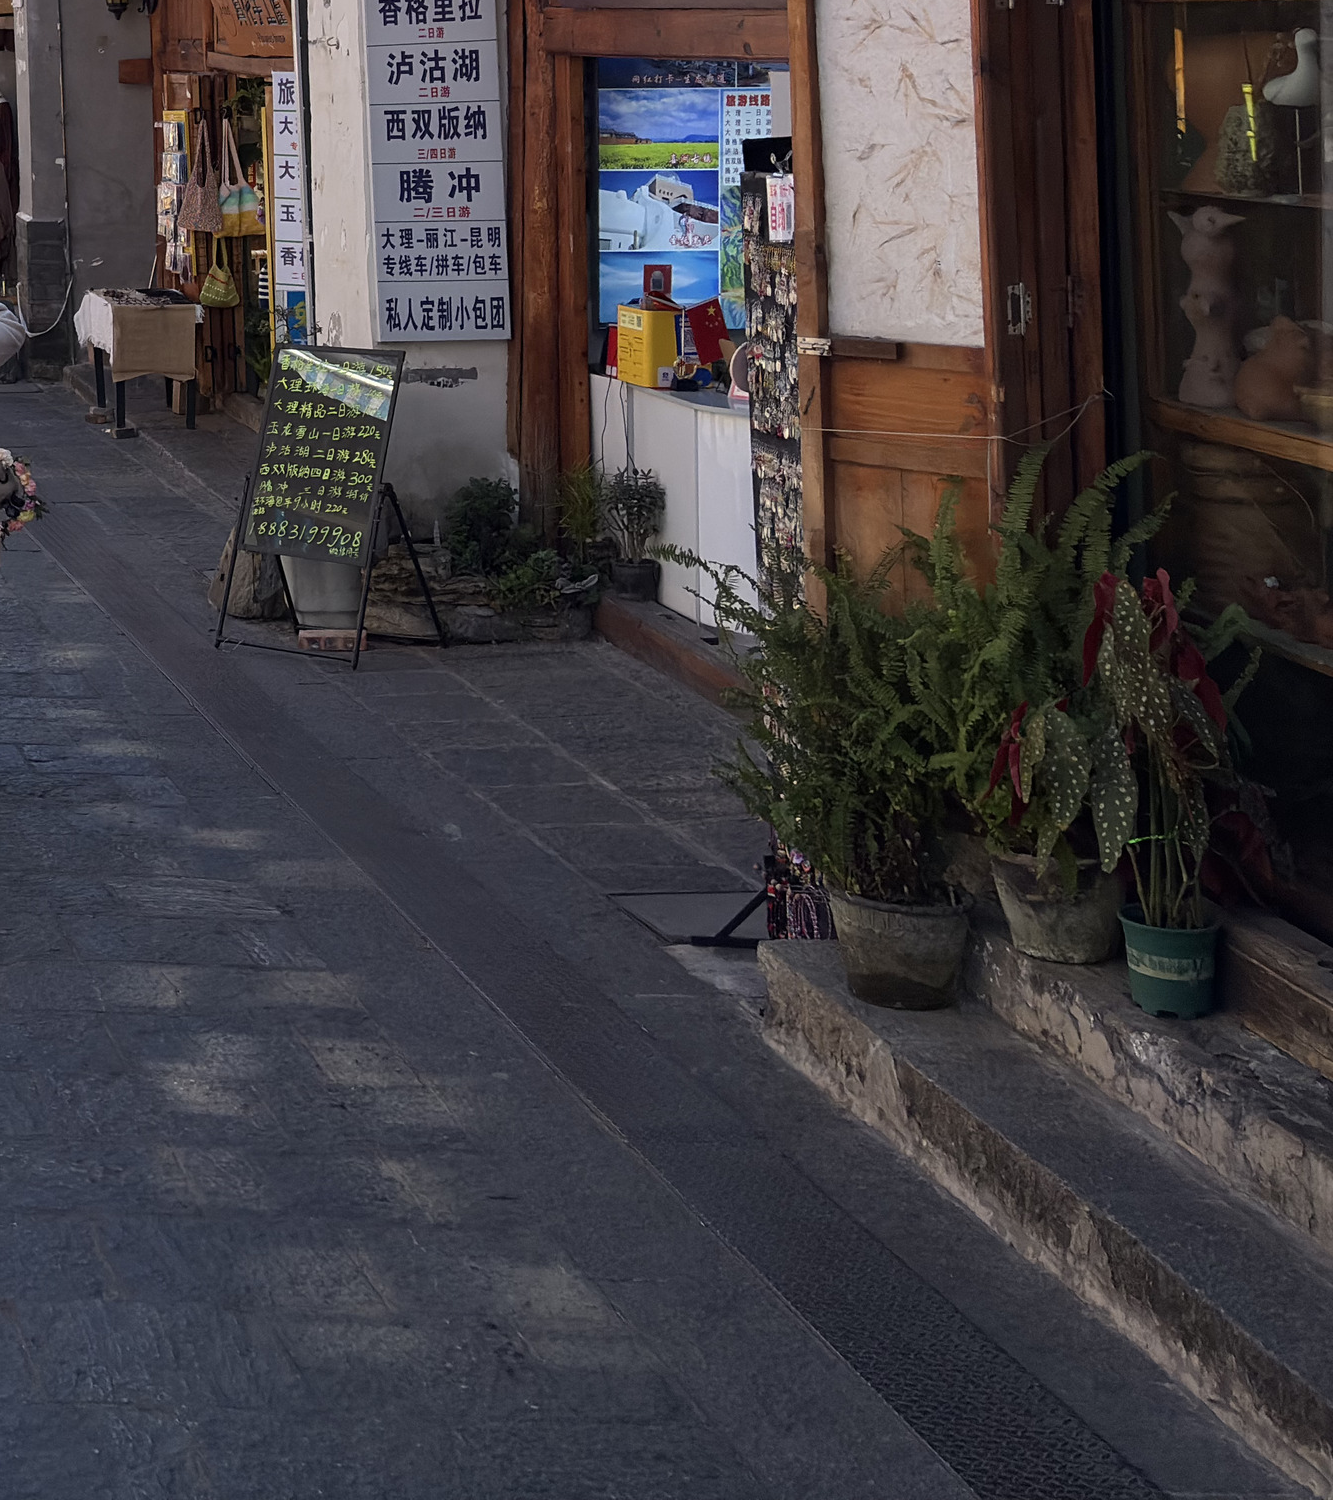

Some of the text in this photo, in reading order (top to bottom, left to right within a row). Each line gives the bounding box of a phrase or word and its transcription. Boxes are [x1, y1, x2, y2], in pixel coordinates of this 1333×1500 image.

[418, 27, 445, 40] 二日游
[387, 48, 480, 85] 泸沽湖
[278, 78, 295, 105] 旅
[419, 85, 451, 99] 二日游
[725, 94, 771, 107] 旅游线路
[386, 104, 488, 141] 西双版纳
[417, 147, 456, 160] 三/四日游
[399, 167, 481, 203] 腾冲
[413, 206, 471, 219] 二/三日游
[382, 227, 502, 251] 大理-丽江-昆明
[383, 254, 502, 277] 专线车/拼车/包车
[386, 296, 506, 332] 私人定制小包团
[248, 520, 362, 548] 18883199908
